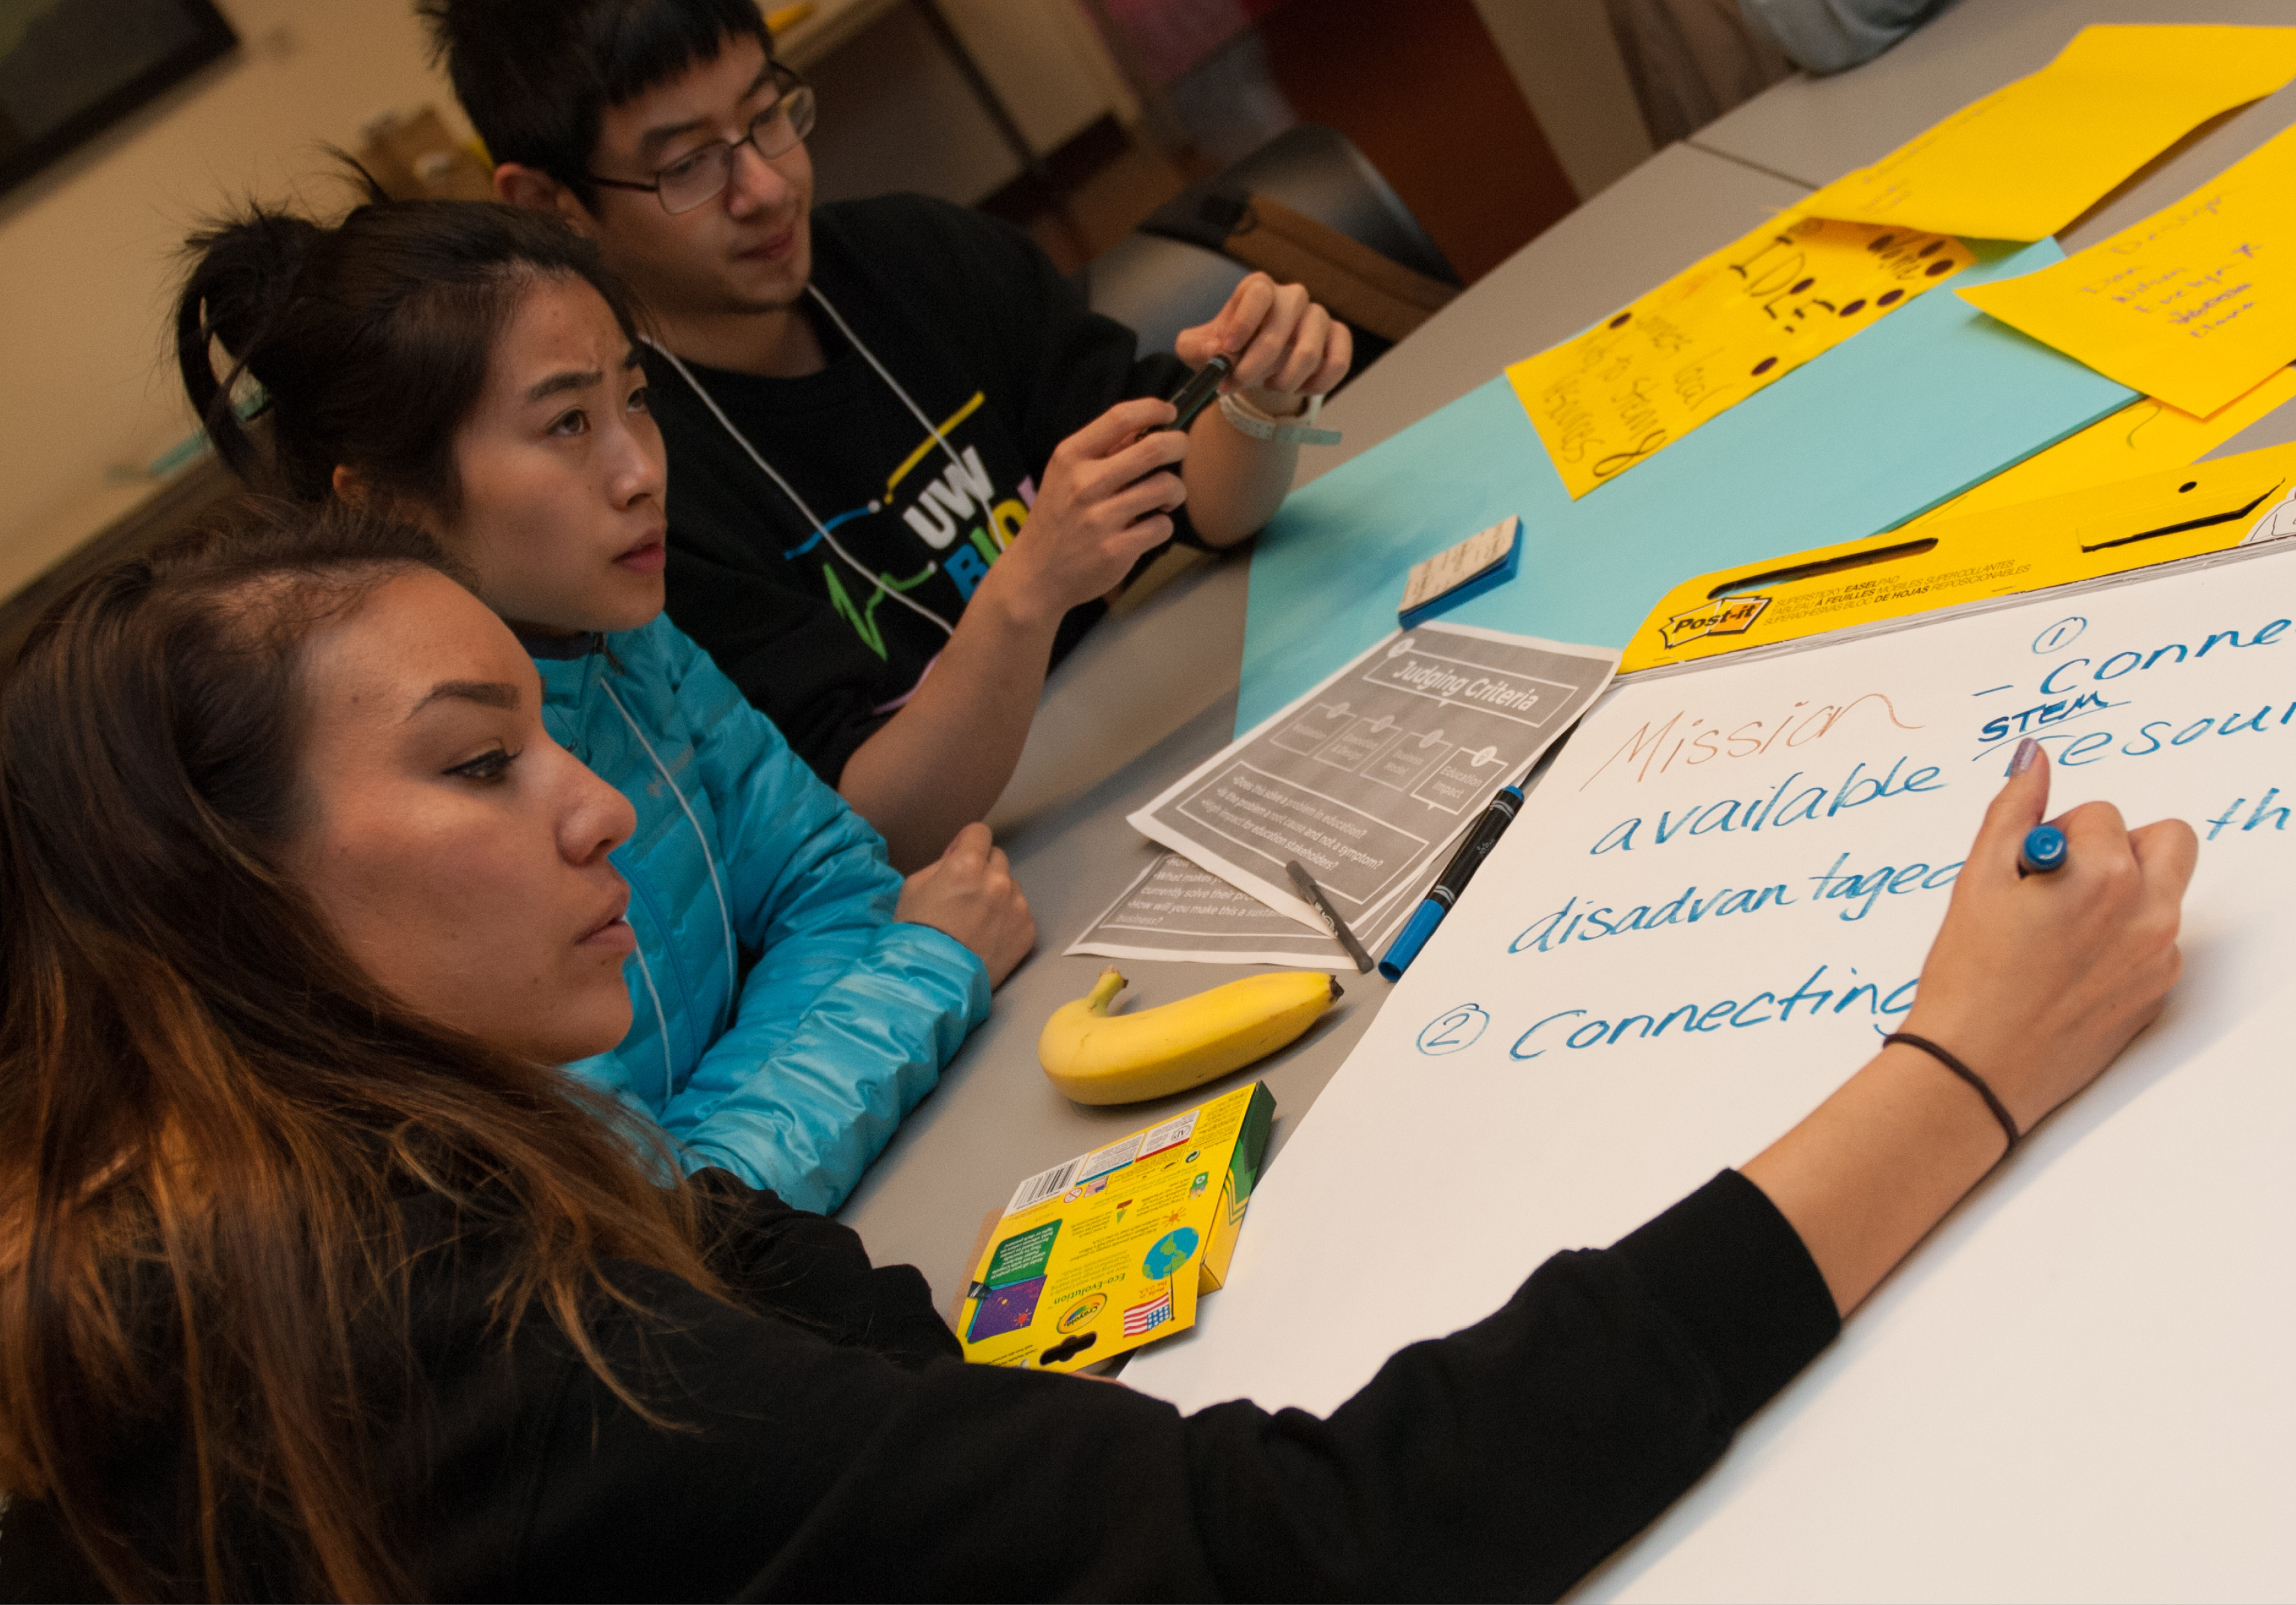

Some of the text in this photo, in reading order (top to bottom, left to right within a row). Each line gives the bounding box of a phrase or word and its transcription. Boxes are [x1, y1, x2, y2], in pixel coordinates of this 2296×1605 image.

[902, 445, 995, 550] UW
[943, 475, 1040, 602] BIO
[1824, 588, 1875, 605] FEUILLES
[1876, 580, 1922, 596] MOBILES
[1924, 560, 2015, 585] SUPERCOLLANTES
[1874, 593, 1890, 603] DE
[1892, 585, 1929, 602] HOJAS
[1931, 564, 2031, 592] REPOSICIONABLES
[1671, 603, 1756, 634] Post-it
[2040, 619, 2296, 695] Conne
[1392, 660, 1540, 712] Judging Criteria
[1977, 691, 2109, 742] STEM
[1580, 693, 1926, 792] Mission
[1431, 781, 1465, 800] Impact
[1439, 765, 1485, 789] Education
[1265, 789, 1283, 801] solve
[1285, 799, 1317, 816] problem
[1323, 813, 1368, 839] education?
[1590, 756, 1949, 855] available
[1237, 798, 1267, 815] problem
[1270, 811, 1285, 825] root
[1283, 818, 1305, 833] cause
[1304, 828, 1320, 841] and
[1320, 835, 1334, 848] not
[1338, 845, 1384, 871] symptom?
[1251, 823, 1285, 845] education
[1285, 839, 1339, 871] stakeholders?
[1141, 887, 1183, 900] currently
[1184, 889, 1210, 899] solve
[1210, 890, 1232, 900] their
[1157, 873, 1183, 882] What
[1181, 875, 1212, 883] makes
[1131, 900, 1154, 910] How
[1153, 901, 1171, 912] will
[1170, 904, 1190, 915] you
[1190, 904, 1219, 915] make
[1218, 905, 1237, 916] this
[1054, 1274, 1123, 1305] Eco-Evolution
[1065, 1306, 1098, 1327] Crayola
